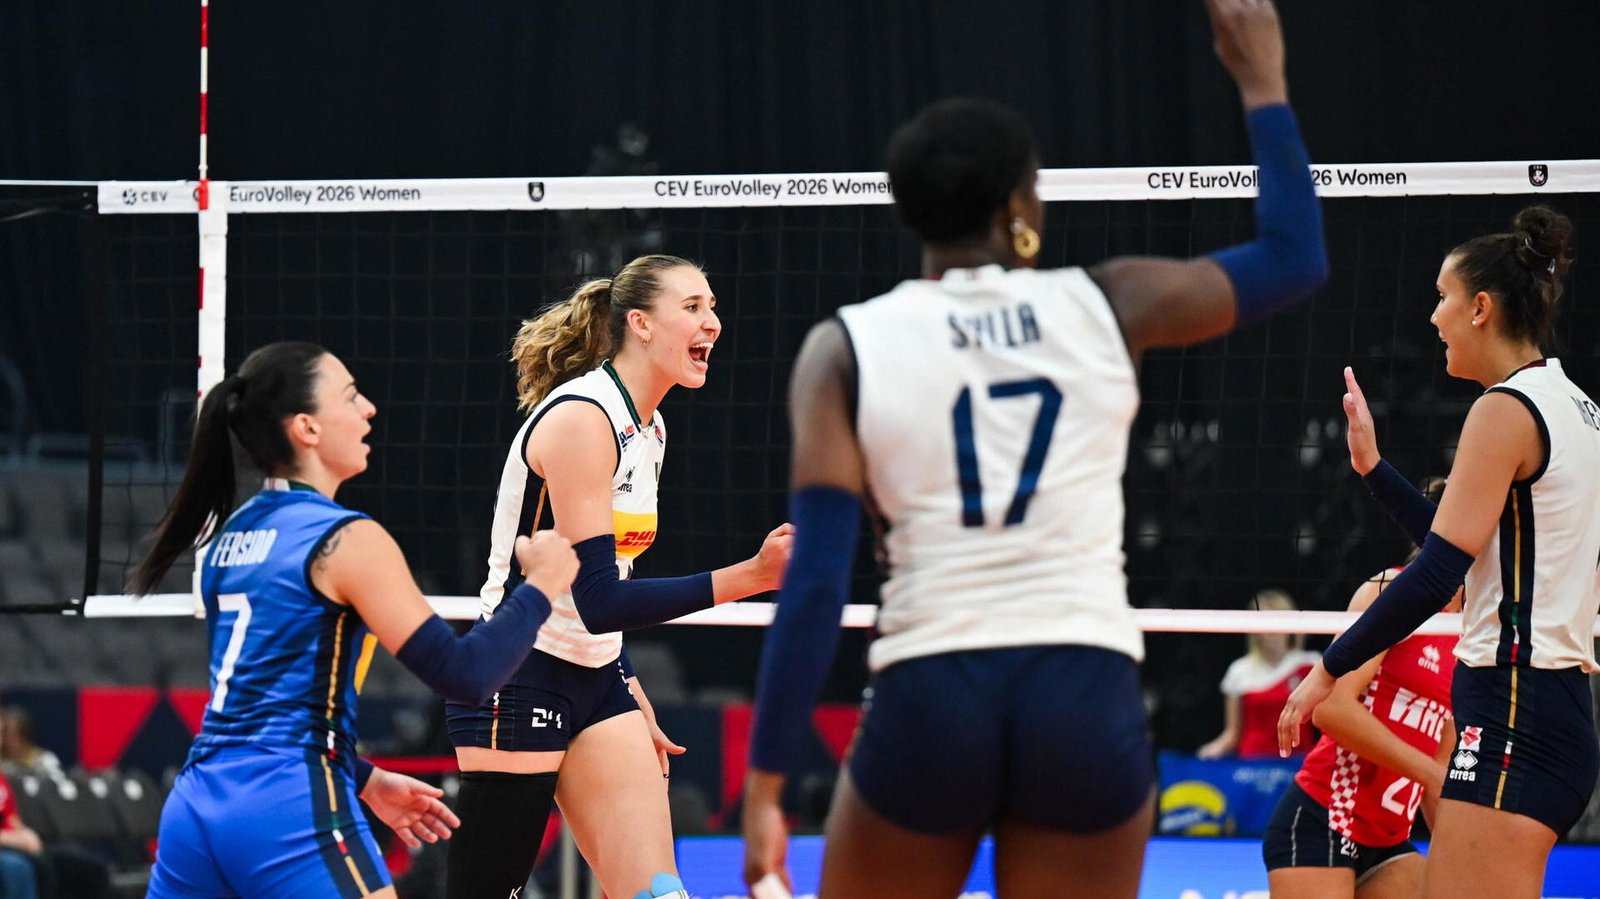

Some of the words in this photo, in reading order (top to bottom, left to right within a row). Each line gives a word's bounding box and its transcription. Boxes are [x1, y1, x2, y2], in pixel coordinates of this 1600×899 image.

[1147, 171, 1184, 189] CEV
[1189, 170, 1260, 188] EuroVoll
[1311, 168, 1332, 186] 26
[1337, 168, 1407, 186] Women
[141, 190, 168, 201] CEV
[230, 185, 312, 205] EuroVolley
[316, 185, 356, 201] 2026
[358, 184, 421, 201] Women
[654, 180, 689, 197] CEV
[694, 178, 782, 199] EuroVolley
[787, 178, 828, 195] 2026
[951, 376, 1064, 528] 17
[211, 592, 253, 714] 7
[1449, 769, 1476, 782] errea
